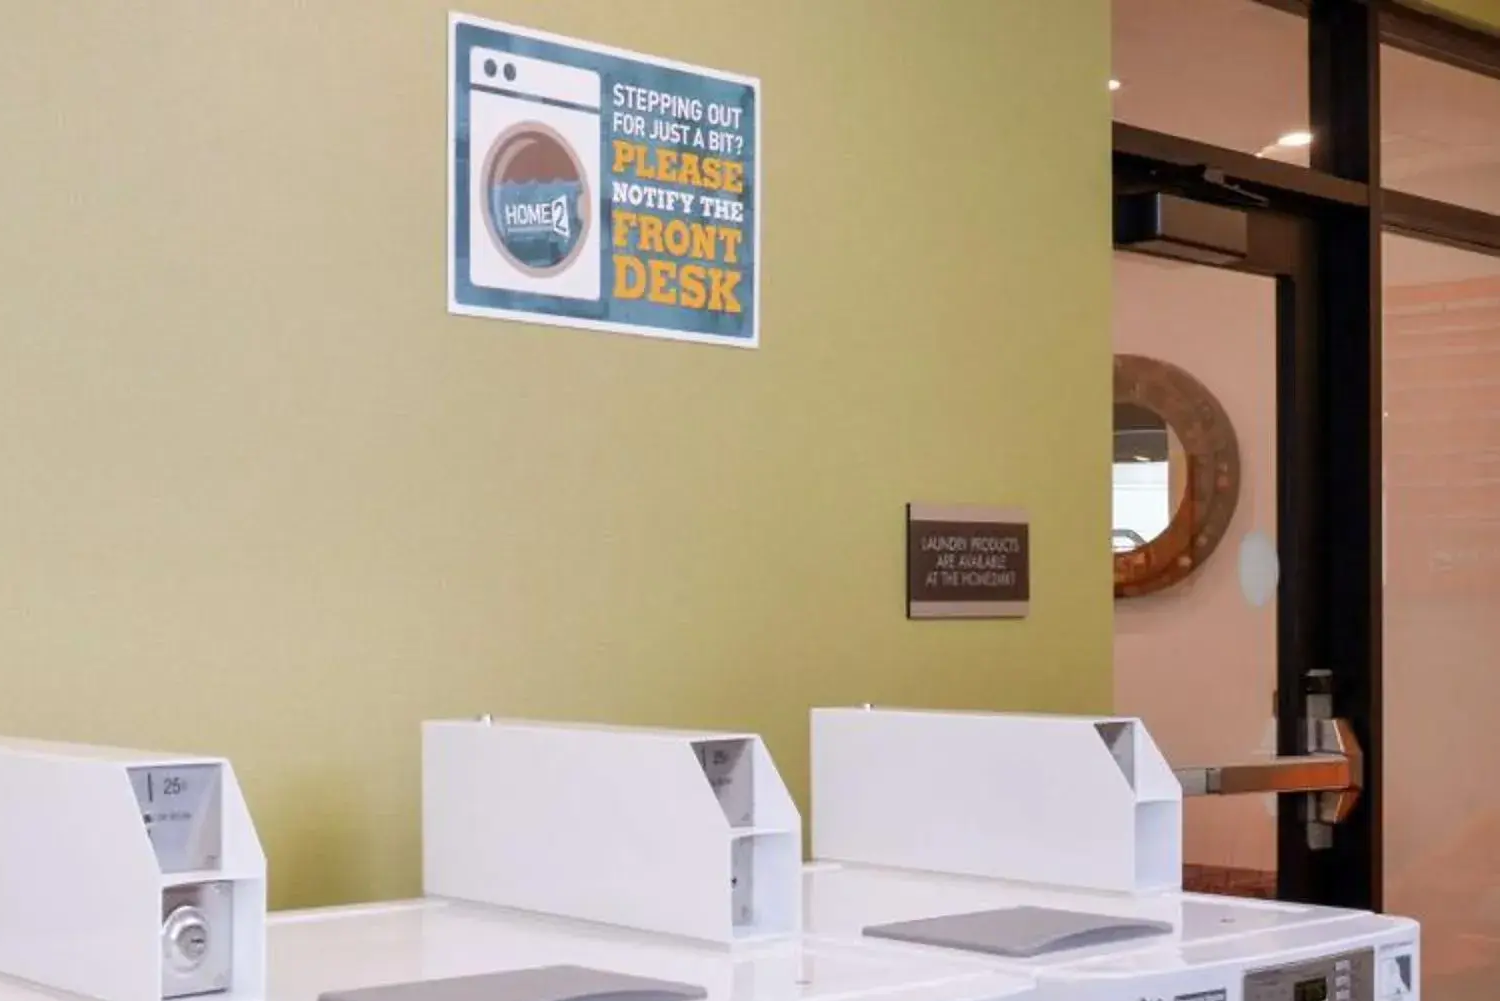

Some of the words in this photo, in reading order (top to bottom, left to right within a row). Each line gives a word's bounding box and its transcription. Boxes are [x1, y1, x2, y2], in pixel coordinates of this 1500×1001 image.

[612, 83, 702, 121] STEPPING
[708, 101, 742, 130] OUT
[613, 112, 645, 138] FOR
[650, 120, 690, 146] JUST
[692, 130, 704, 149] A
[708, 129, 743, 155] BIT?
[612, 139, 743, 193] PLEASE
[612, 181, 695, 213] NOTIFY
[700, 194, 744, 222] THE
[612, 210, 742, 264] FRONT
[612, 254, 742, 313] DESK
[921, 536, 967, 551] LAUNDRY
[970, 537, 1020, 553] PRODUCTS
[936, 554, 956, 570] ARE
[959, 554, 1007, 570] AVAILABLE
